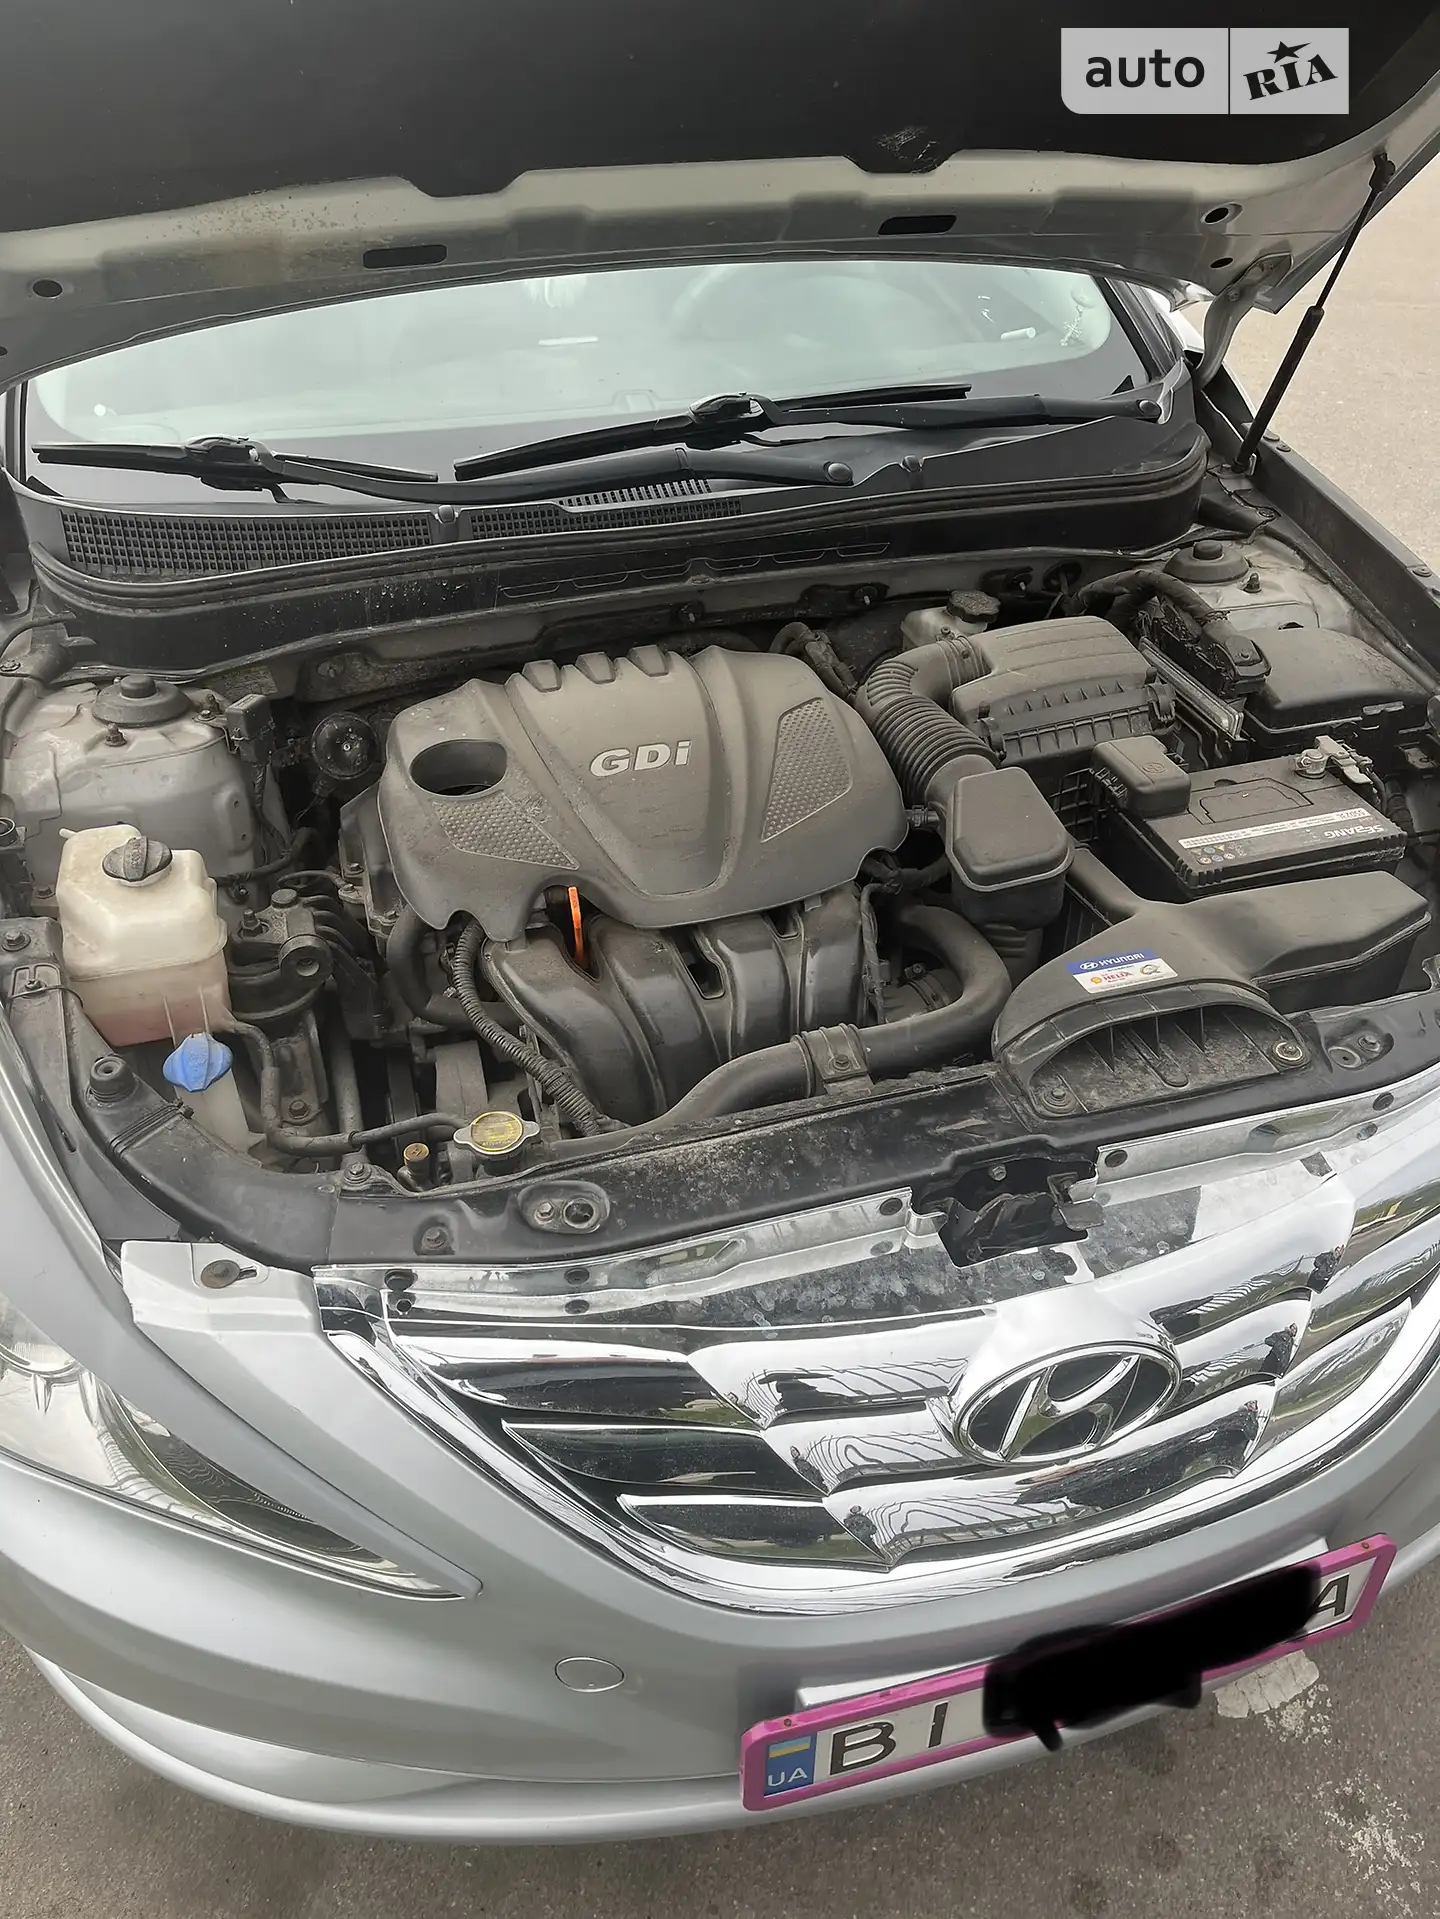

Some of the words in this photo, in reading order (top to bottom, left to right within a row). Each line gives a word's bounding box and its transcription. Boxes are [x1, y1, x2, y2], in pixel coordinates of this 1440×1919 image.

[589, 739, 691, 777] GDi
[1324, 825, 1384, 839] SEBANG
[1098, 952, 1145, 966] HYUNDAI
[767, 1767, 808, 1787] UA
